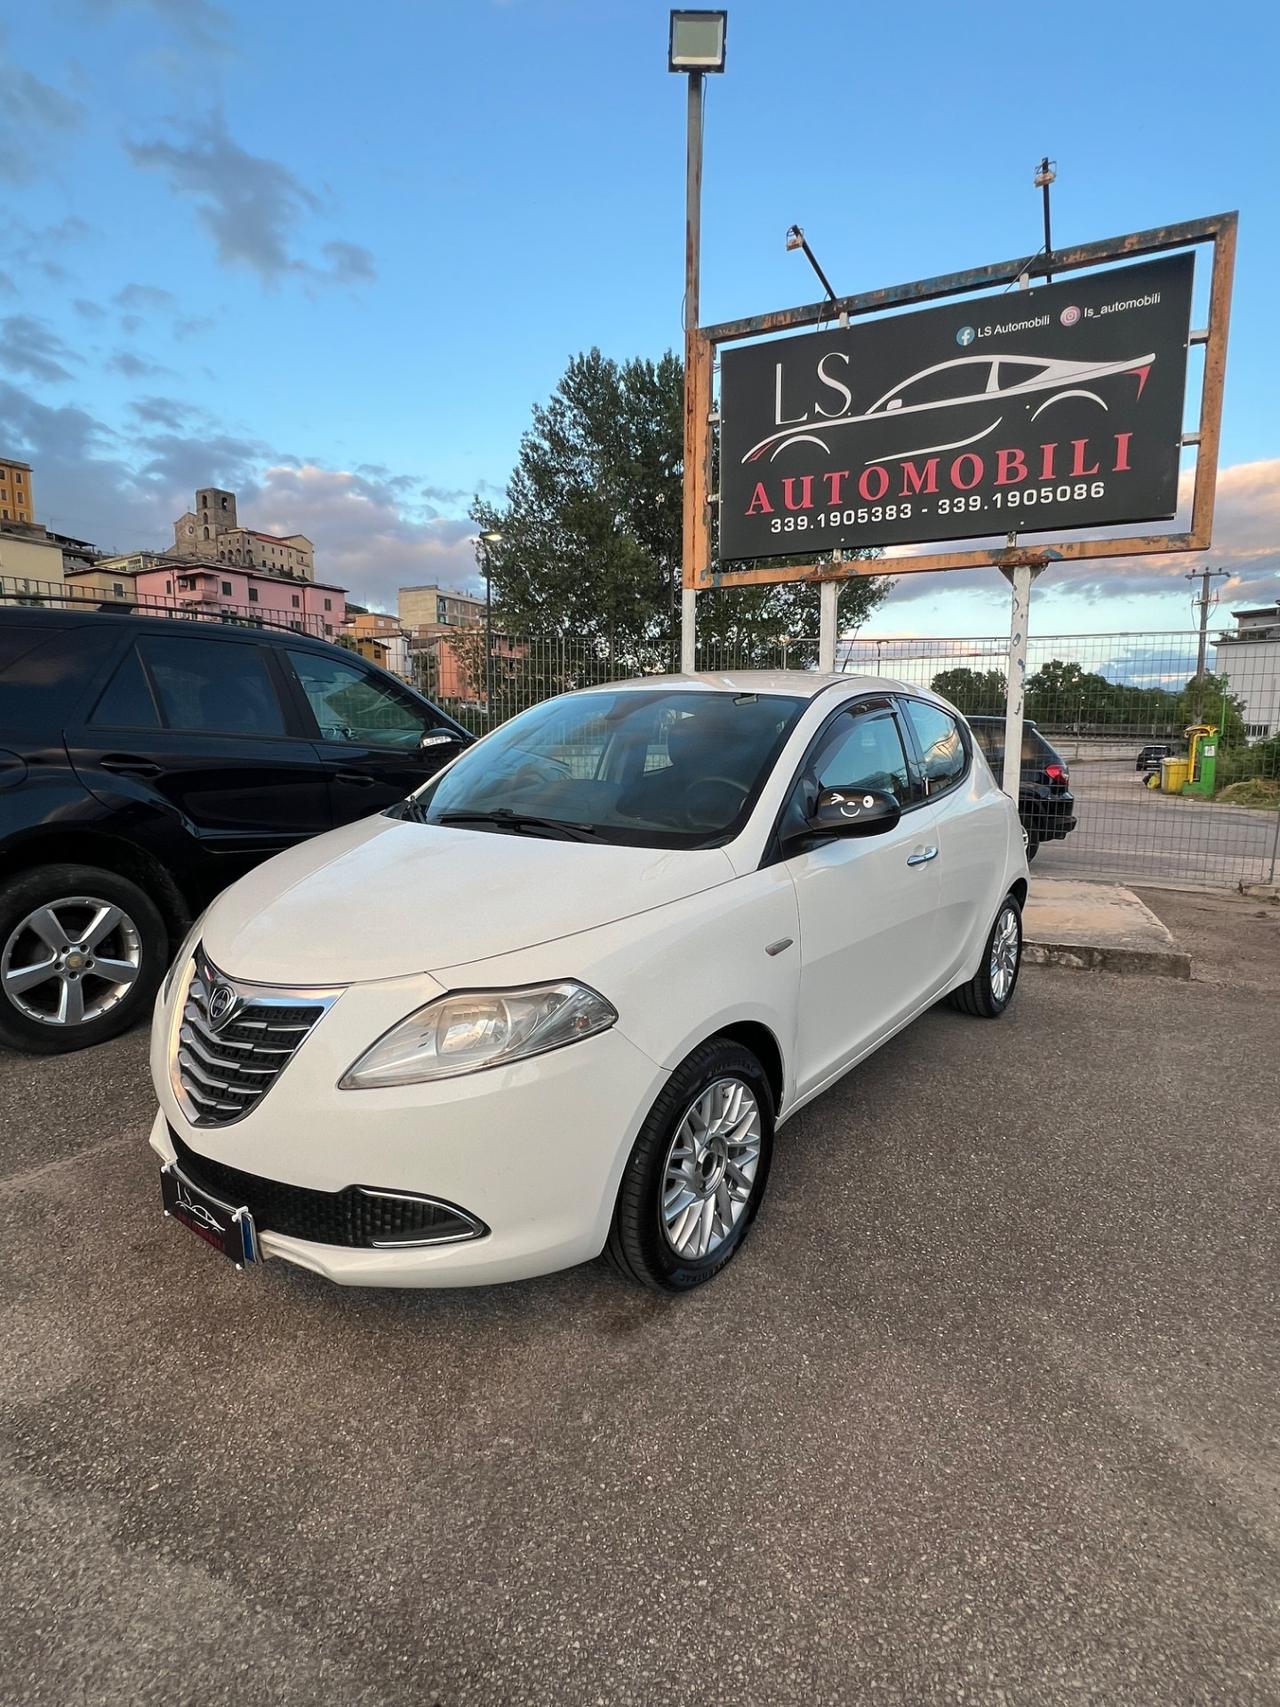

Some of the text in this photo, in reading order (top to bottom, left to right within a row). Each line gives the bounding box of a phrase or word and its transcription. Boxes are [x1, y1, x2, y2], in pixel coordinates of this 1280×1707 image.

[977, 314, 1050, 338] LS Automobili
[1084, 292, 1161, 319] ls_automobili
[775, 352, 852, 425] LS
[745, 432, 1133, 516] AUTOMOBILI
[770, 503, 912, 533] 339.1905383
[937, 481, 1105, 515] 339.1905086
